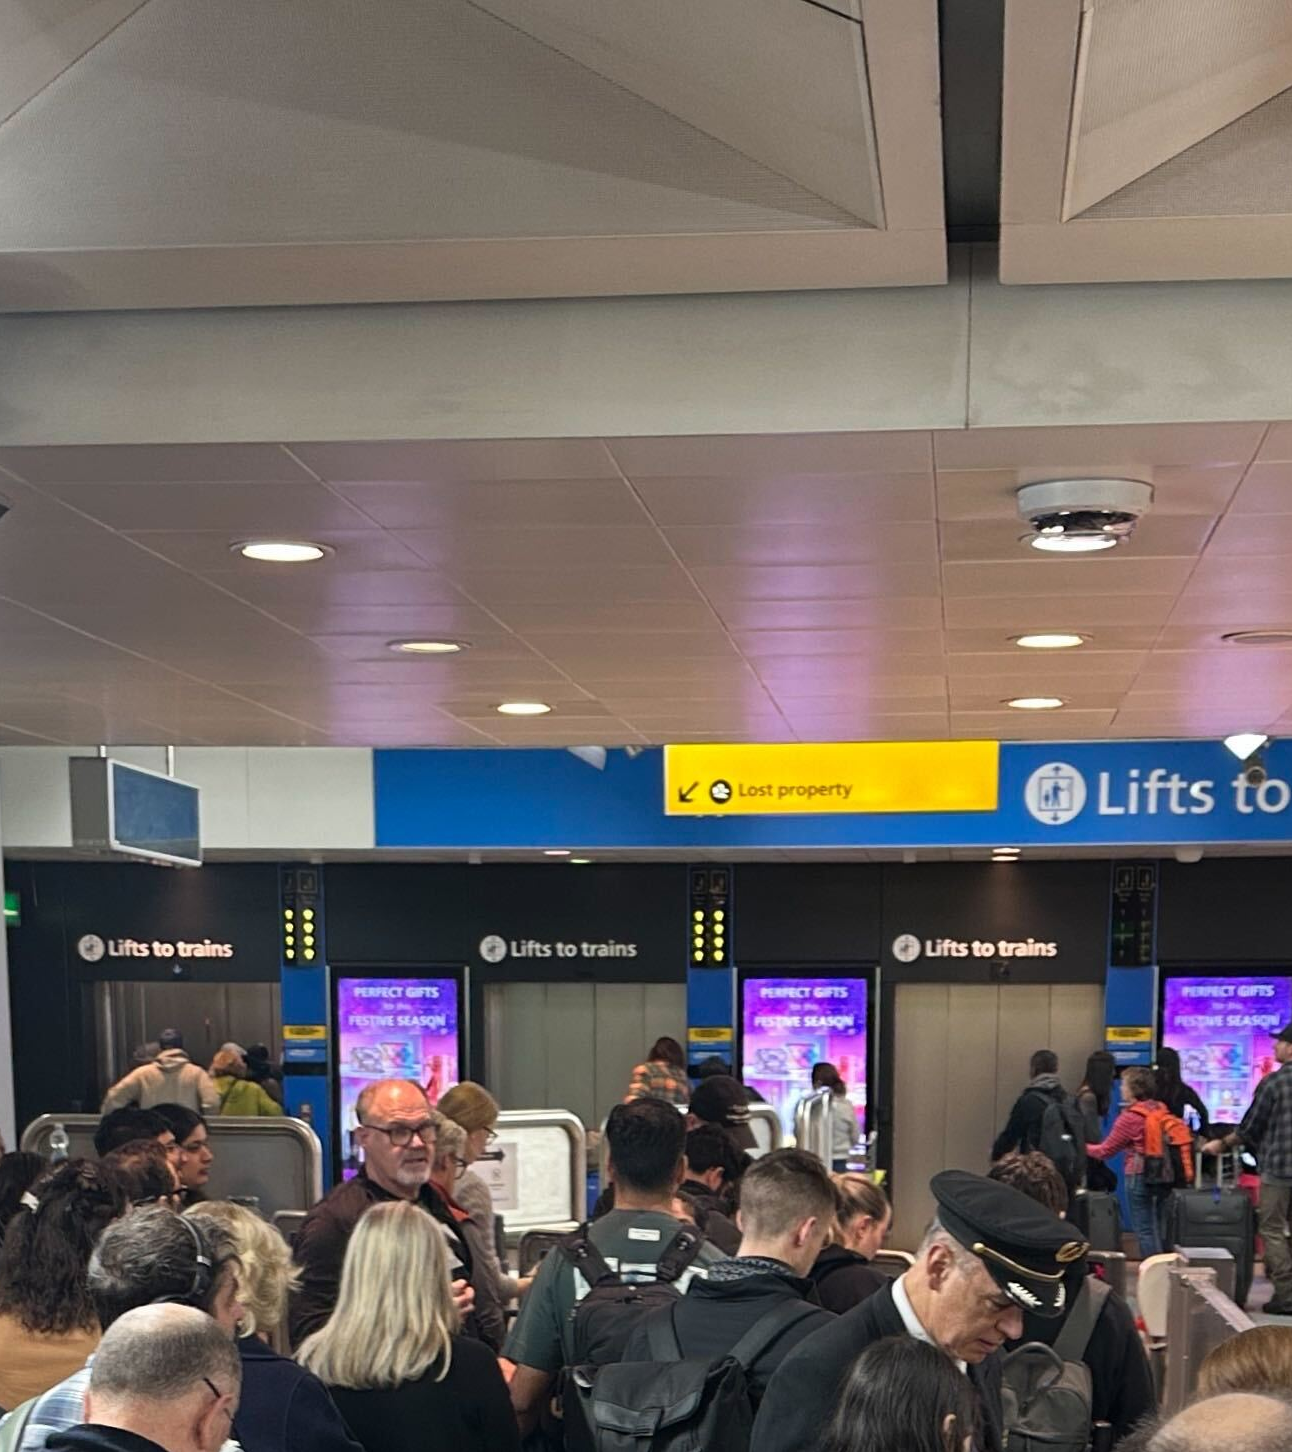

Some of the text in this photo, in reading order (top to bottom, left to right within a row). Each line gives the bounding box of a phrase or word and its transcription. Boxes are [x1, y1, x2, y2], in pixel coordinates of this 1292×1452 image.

[738, 781, 853, 801] Lost property
[1097, 768, 1214, 815] Lifts
[1231, 772, 1291, 814] to
[108, 939, 234, 957] Lifts to trains
[511, 940, 638, 957] Lifts to trains
[925, 938, 1058, 957] Lifts to trains
[352, 986, 440, 998] PERFECT GIFTS
[759, 986, 848, 998] PERFECT GIFTS
[1181, 985, 1275, 997] PERFECT GIFTS
[397, 1015, 446, 1026] SEASON
[803, 1015, 854, 1027] SEASON
[1226, 1014, 1280, 1026] SEASON
